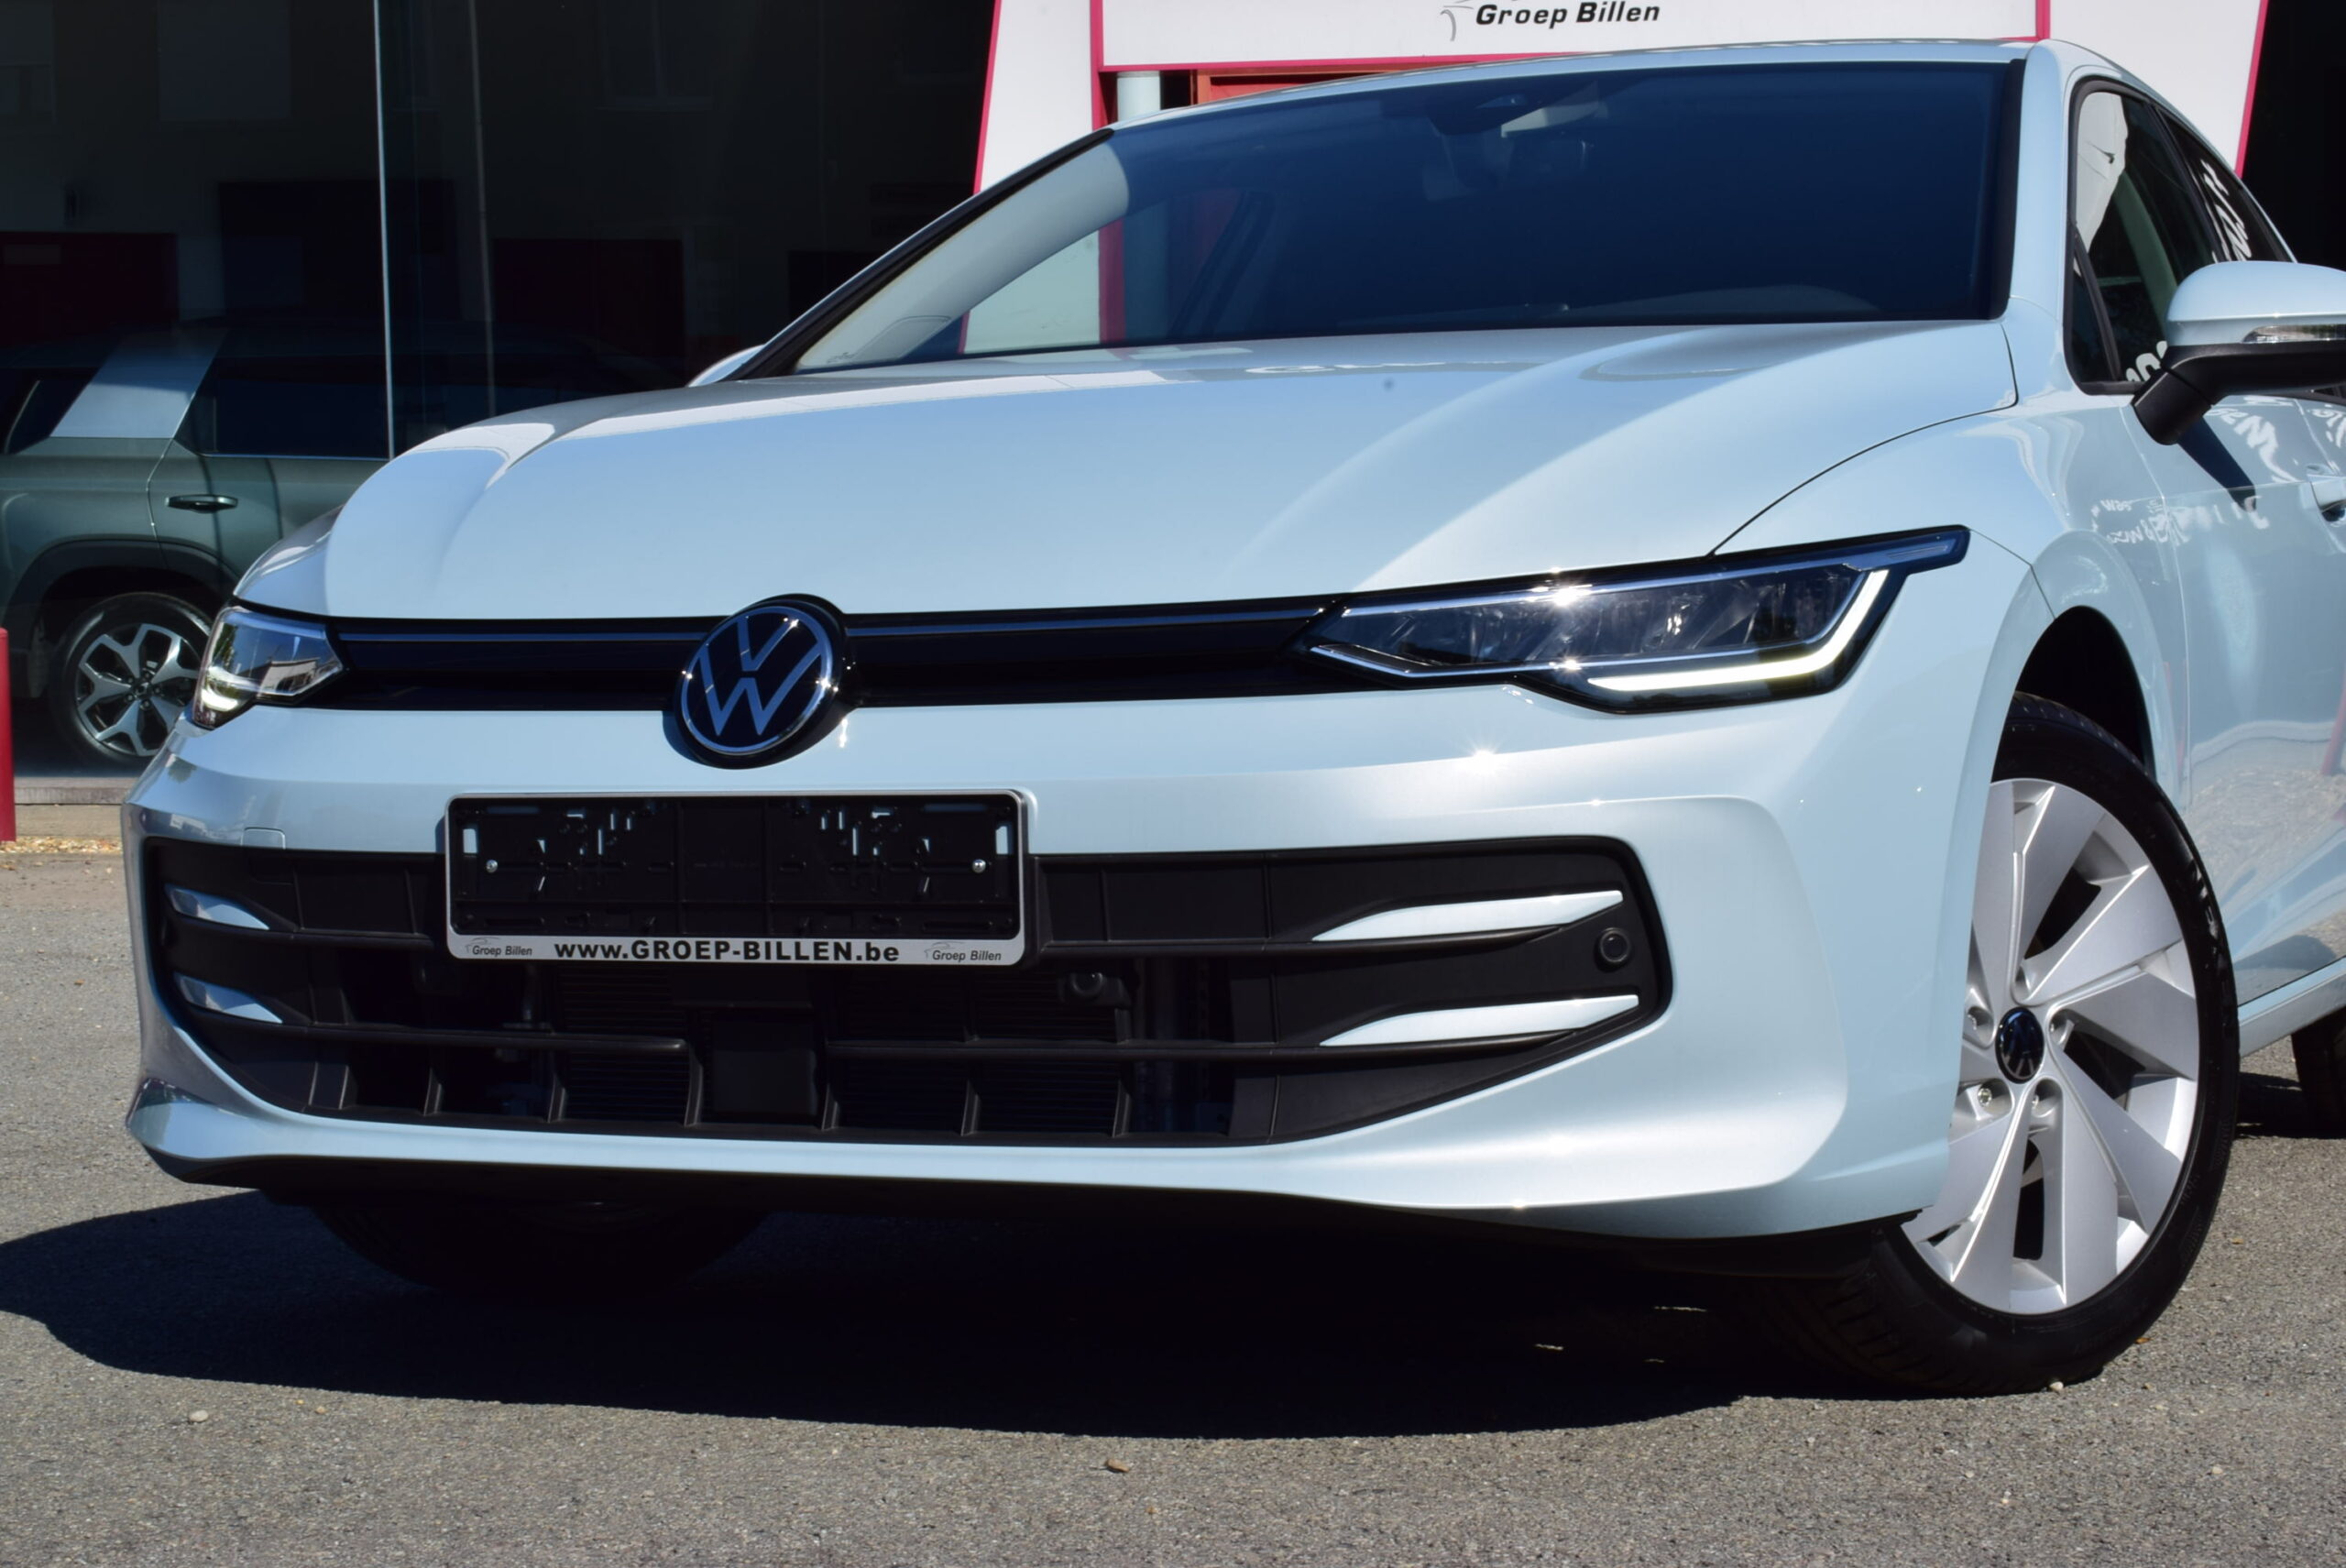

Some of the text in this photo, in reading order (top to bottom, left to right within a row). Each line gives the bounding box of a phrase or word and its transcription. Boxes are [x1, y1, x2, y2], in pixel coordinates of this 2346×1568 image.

[1475, 1, 1661, 29] Groep Billen
[472, 945, 532, 958] Groep Billen
[554, 939, 900, 962] www.GROEP-BILLEN.be
[932, 949, 1002, 963] Groep Billen
